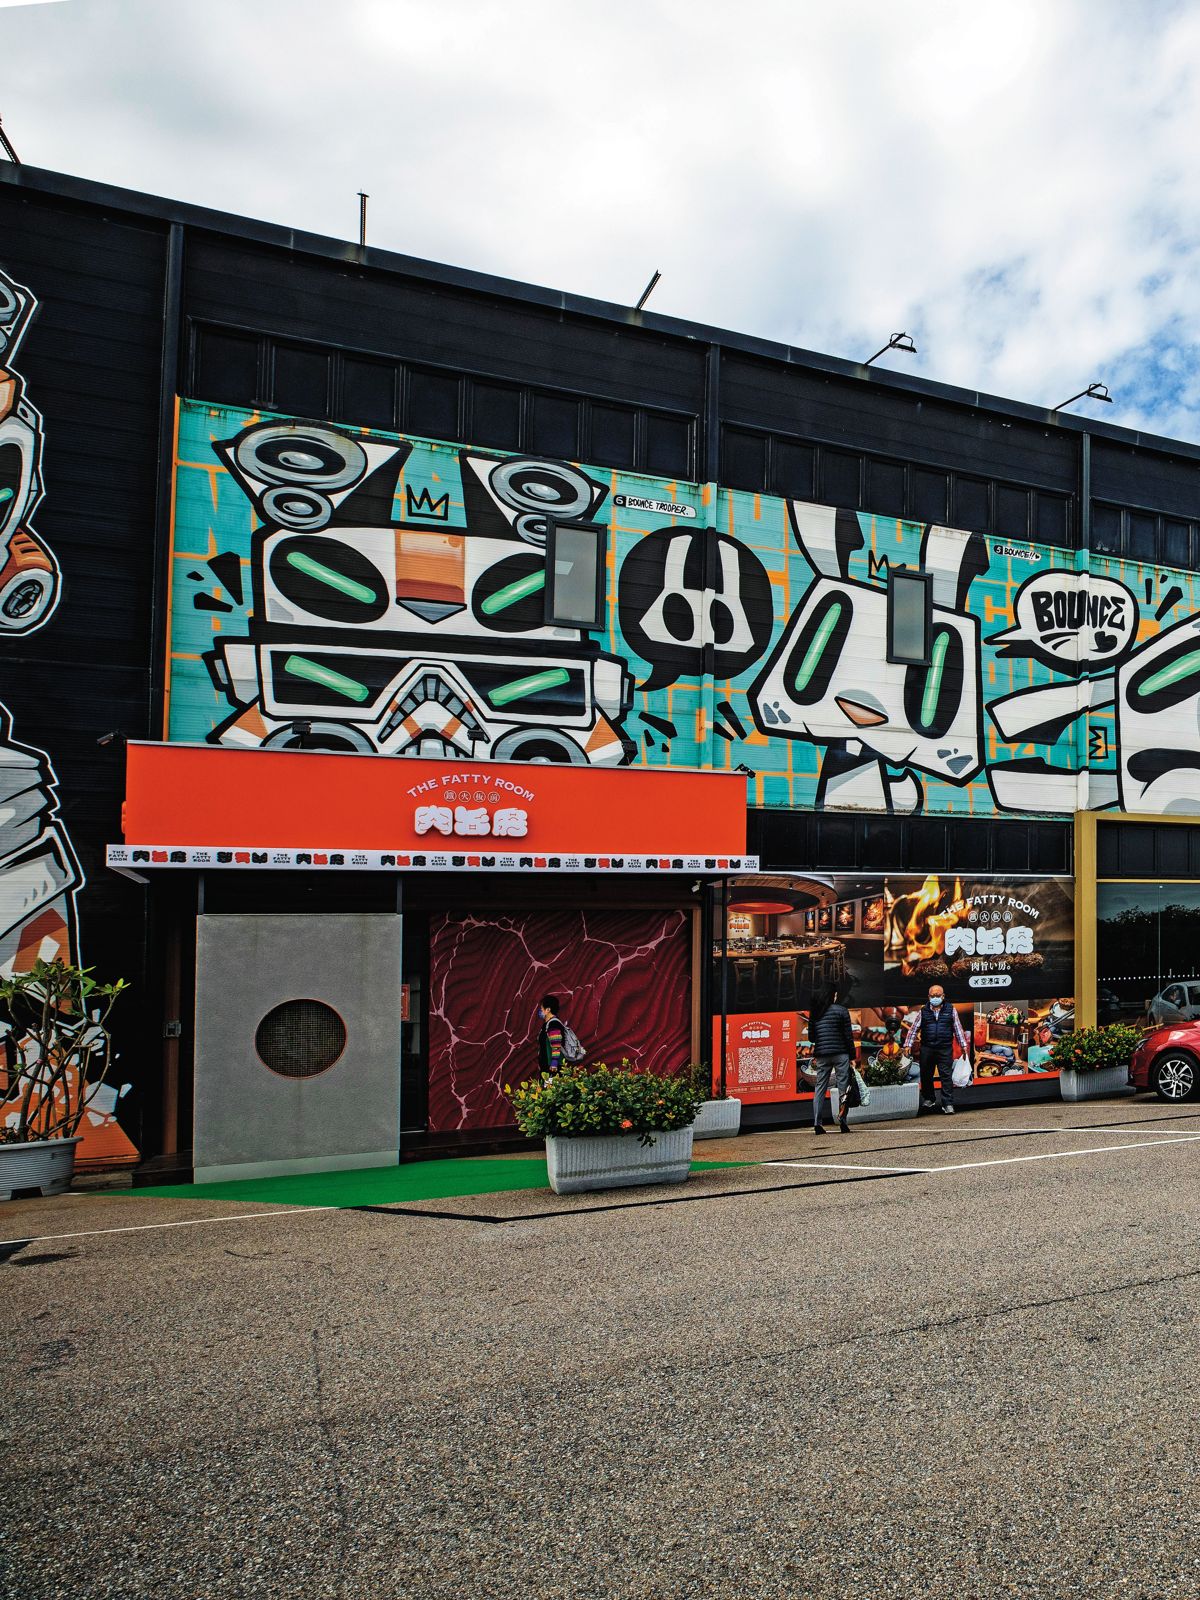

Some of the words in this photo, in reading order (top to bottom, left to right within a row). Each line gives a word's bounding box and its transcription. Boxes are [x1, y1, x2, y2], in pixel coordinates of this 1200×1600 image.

[628, 498, 653, 509] BOUNCE
[656, 503, 688, 515] TROOPER.
[1031, 590, 1126, 632] BOUNCE
[407, 779, 439, 798] THE
[441, 774, 491, 785] FATTY
[494, 778, 535, 802] ROOM
[939, 900, 964, 919] THE
[966, 895, 1005, 907] FATTY
[1007, 898, 1040, 920] ROOM
